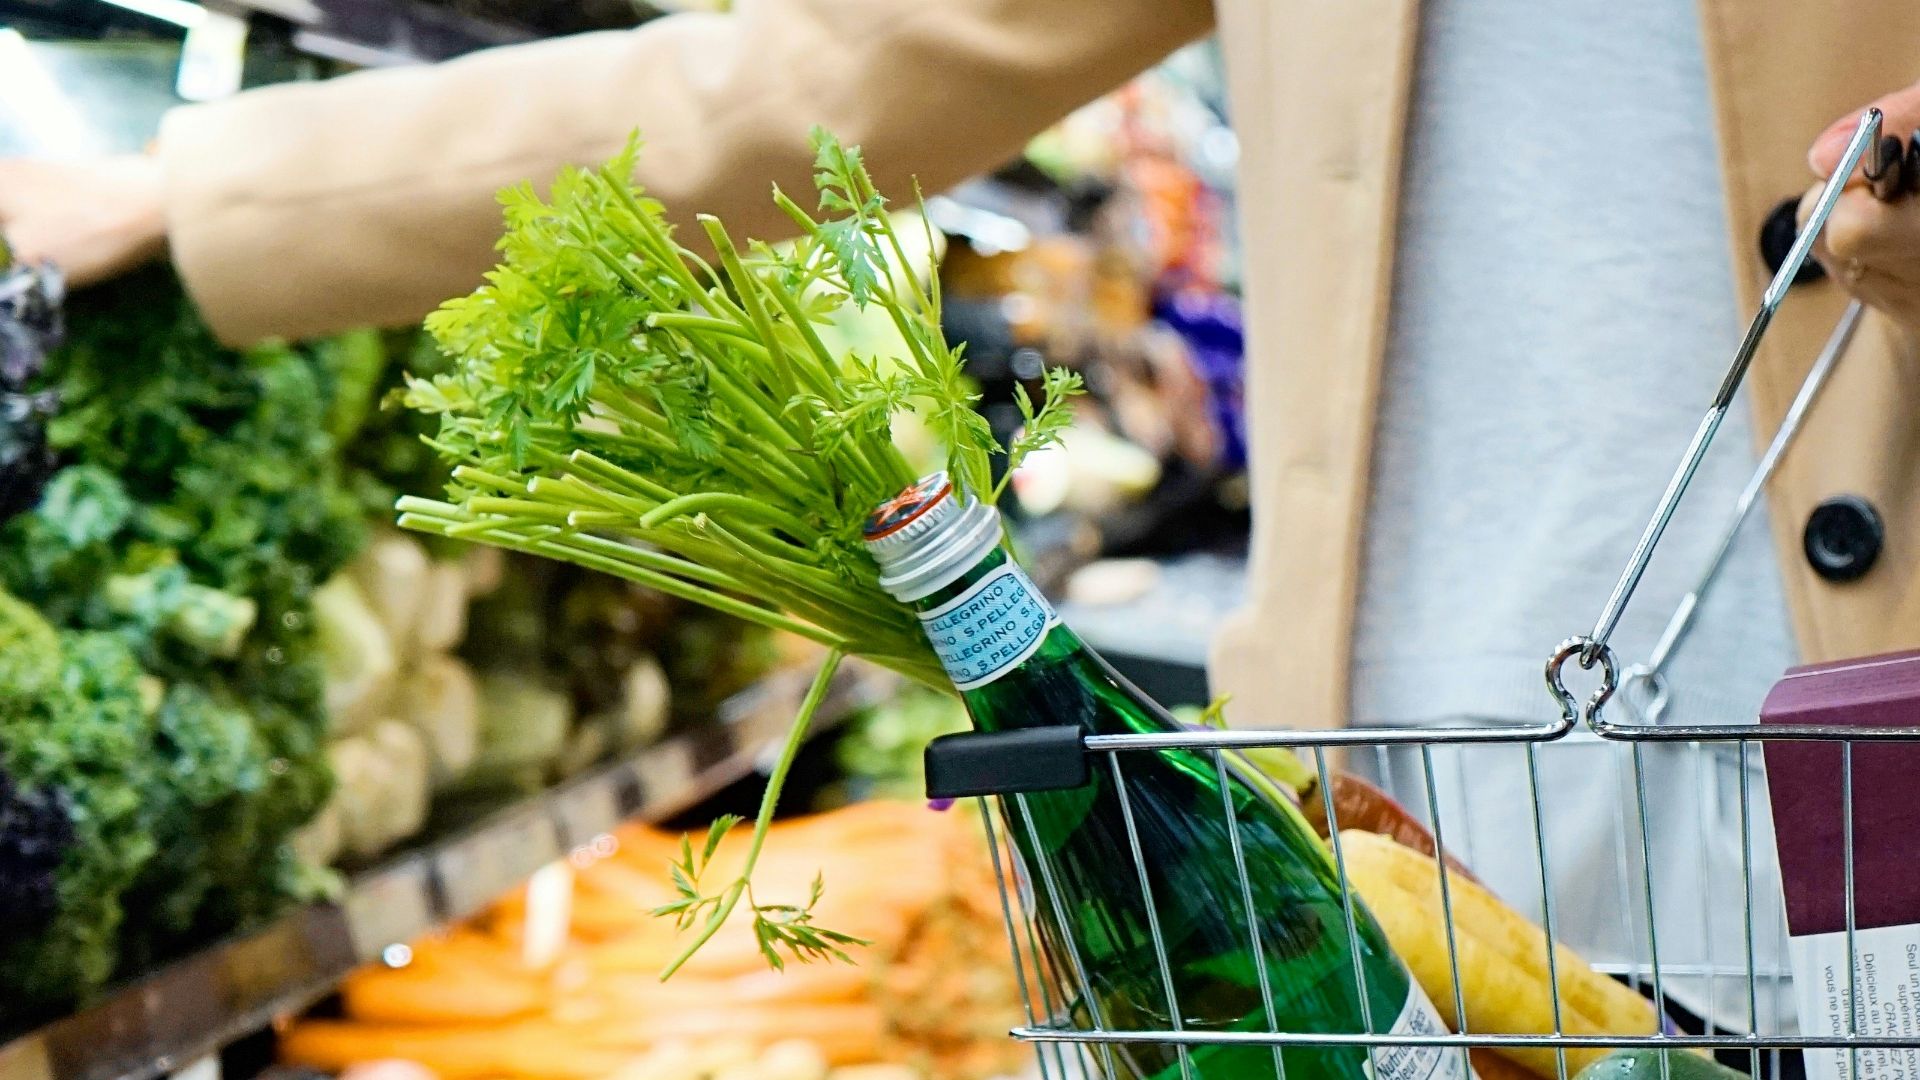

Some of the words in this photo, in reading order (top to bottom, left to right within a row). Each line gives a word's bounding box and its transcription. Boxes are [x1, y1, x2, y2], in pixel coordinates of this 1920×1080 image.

[930, 585, 1004, 632] ELLEGRINO
[1906, 943, 1920, 970] Seul
[1825, 965, 1836, 993] vous
[1863, 953, 1878, 1006] Délicieux
[1909, 973, 1920, 988] un
[1828, 996, 1839, 1011] ne
[1870, 1010, 1880, 1024] au
[1864, 1060, 1875, 1074] de
